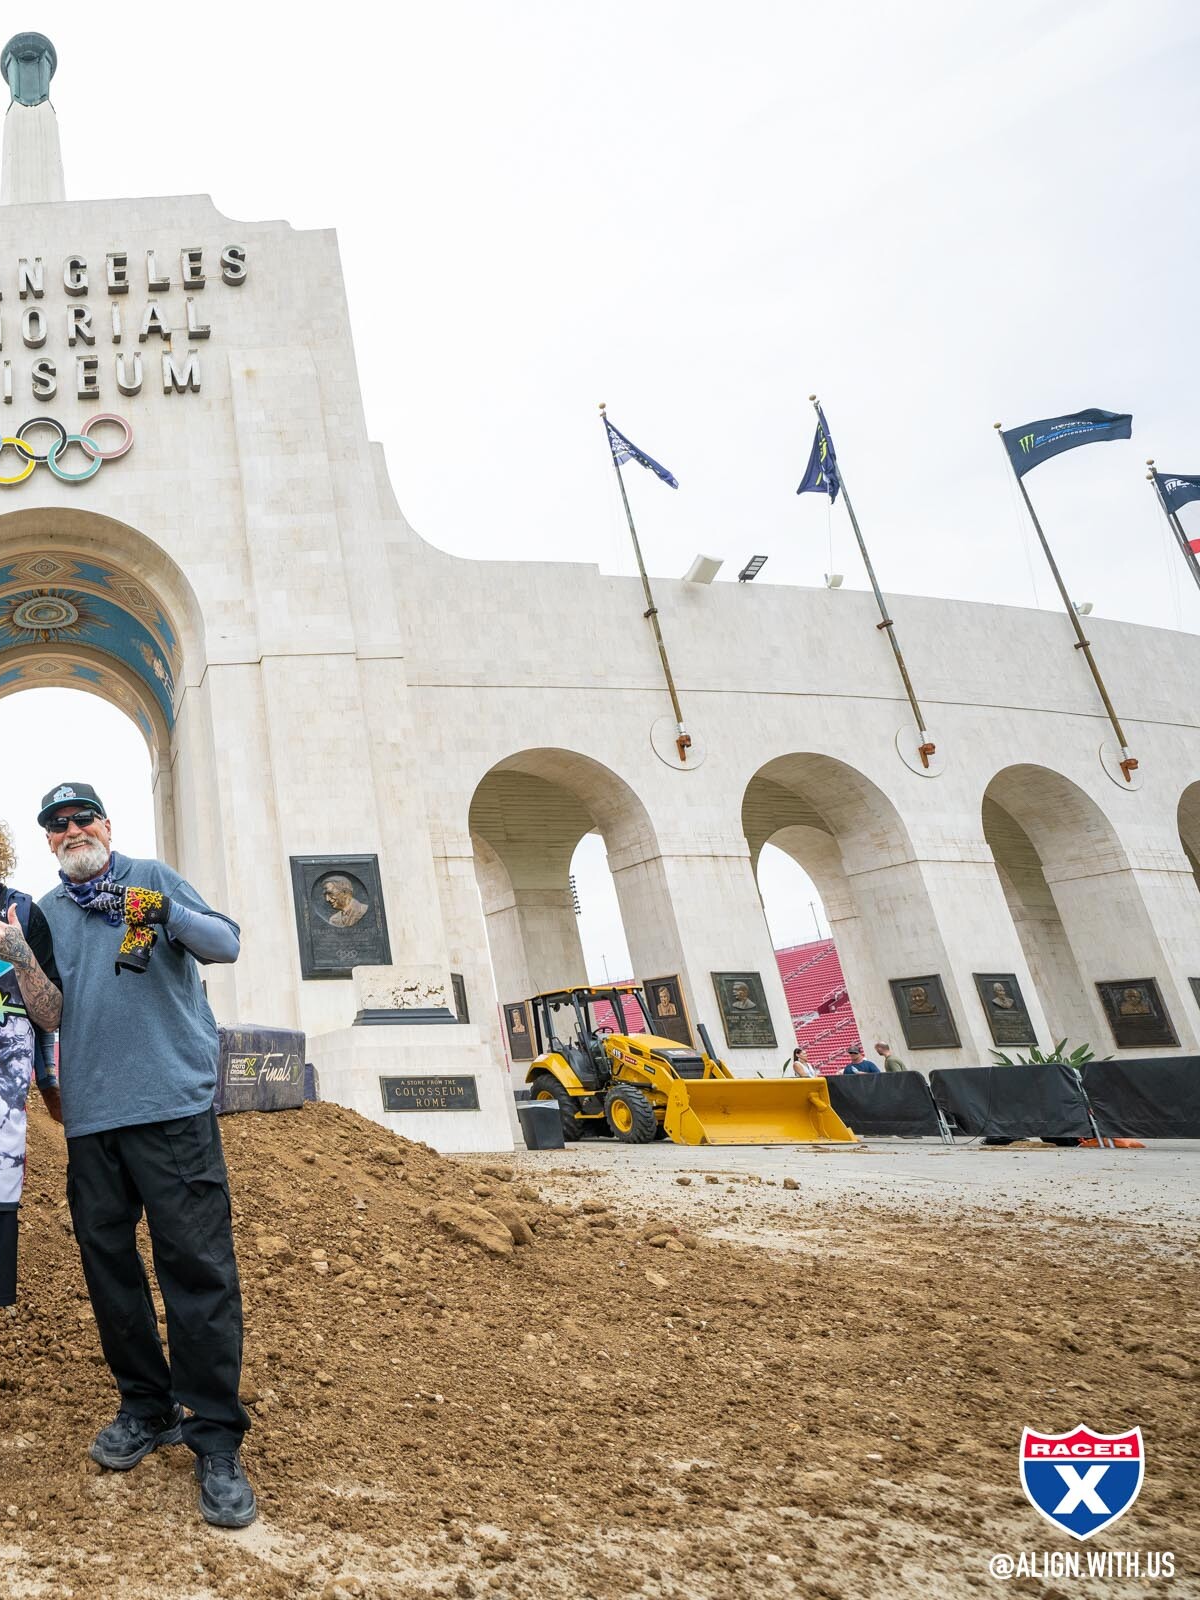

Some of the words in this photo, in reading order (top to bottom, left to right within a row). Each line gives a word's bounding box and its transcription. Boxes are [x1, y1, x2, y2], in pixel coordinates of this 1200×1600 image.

[258, 1051, 292, 1086] Finals
[395, 1087, 464, 1097] COLOSSEUM
[416, 1098, 447, 1107] ROME
